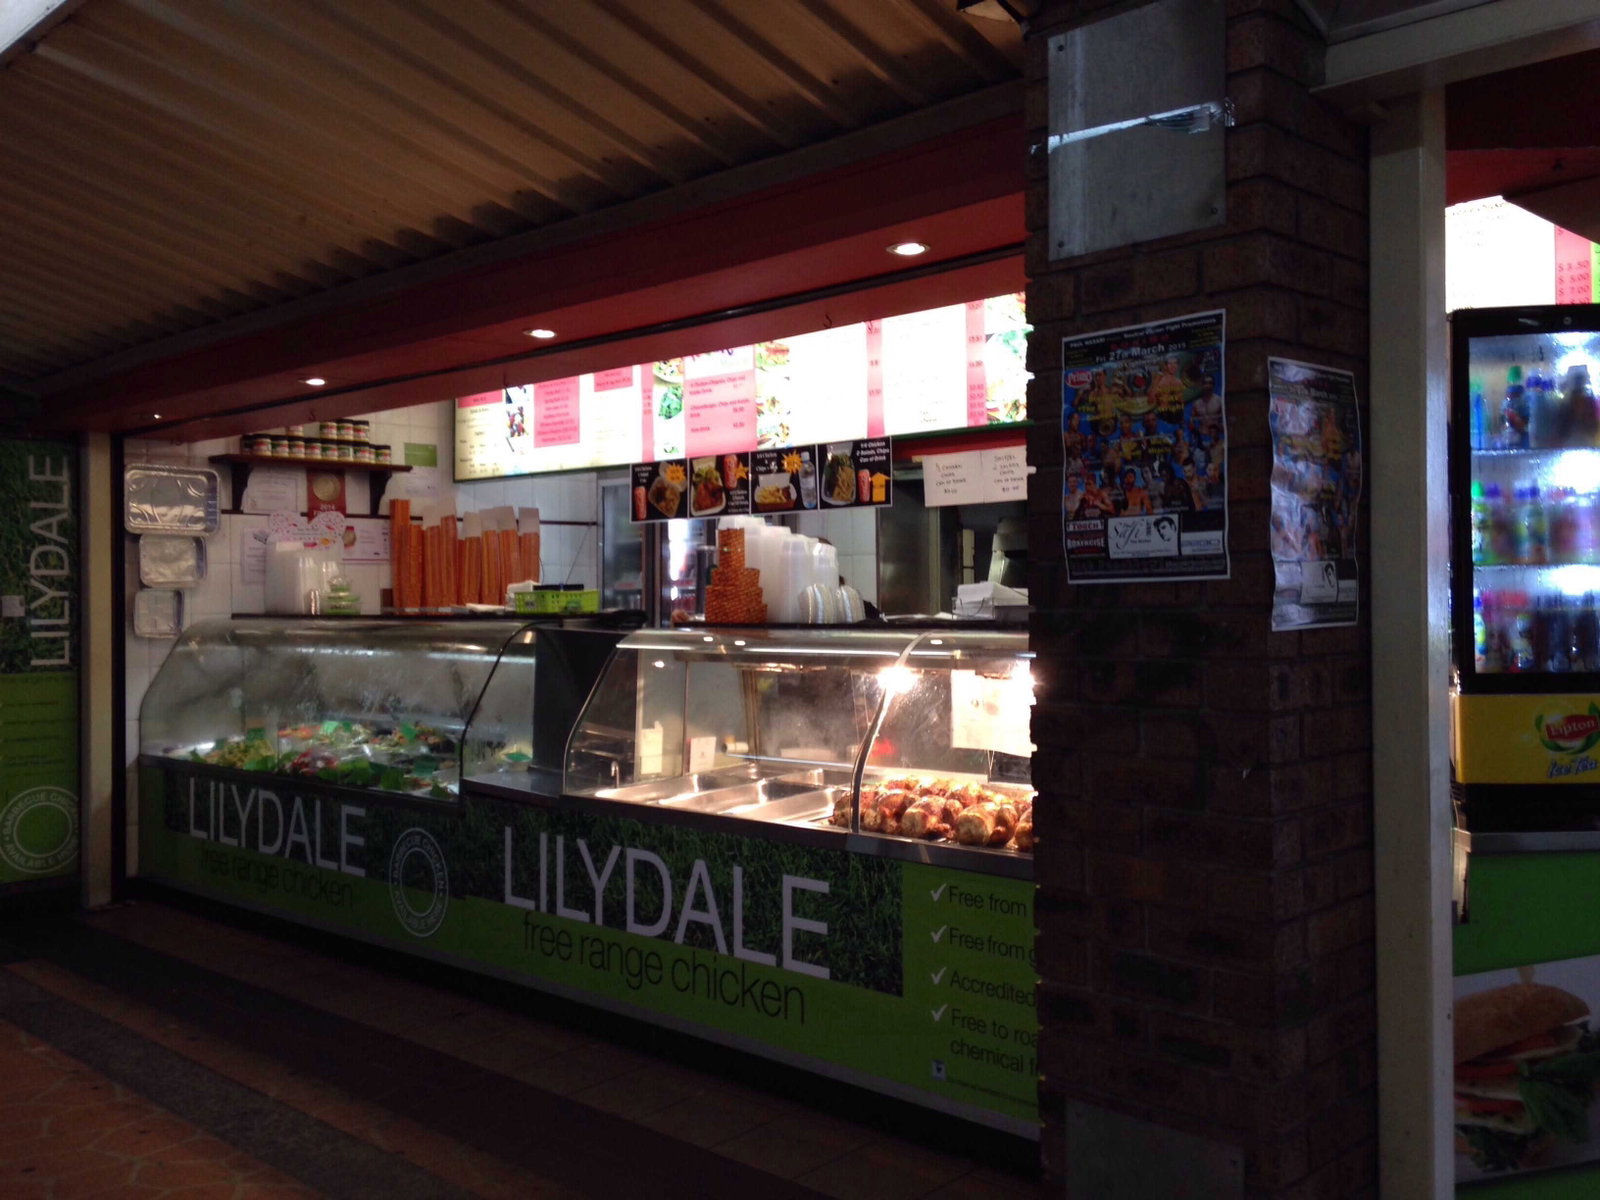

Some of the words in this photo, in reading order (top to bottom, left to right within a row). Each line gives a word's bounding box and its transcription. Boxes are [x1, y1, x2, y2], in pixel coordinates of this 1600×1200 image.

[1131, 340, 1165, 357] March
[28, 454, 71, 667] LILYDALE
[1550, 719, 1596, 737] Lipton
[189, 776, 366, 878] LILYDALE
[231, 855, 281, 894] range
[282, 865, 355, 908] chicken
[504, 826, 831, 980] LILYDALE
[949, 886, 984, 910] Free
[989, 893, 1027, 917] from
[949, 927, 984, 952] Free
[987, 935, 1025, 960] from
[522, 911, 574, 962] free
[579, 934, 663, 991] range
[671, 952, 805, 1024] chicken
[950, 970, 1036, 1007] Accredited
[951, 1008, 986, 1034] Free
[992, 1019, 1009, 1040] to
[949, 1037, 1024, 1073] chemical
